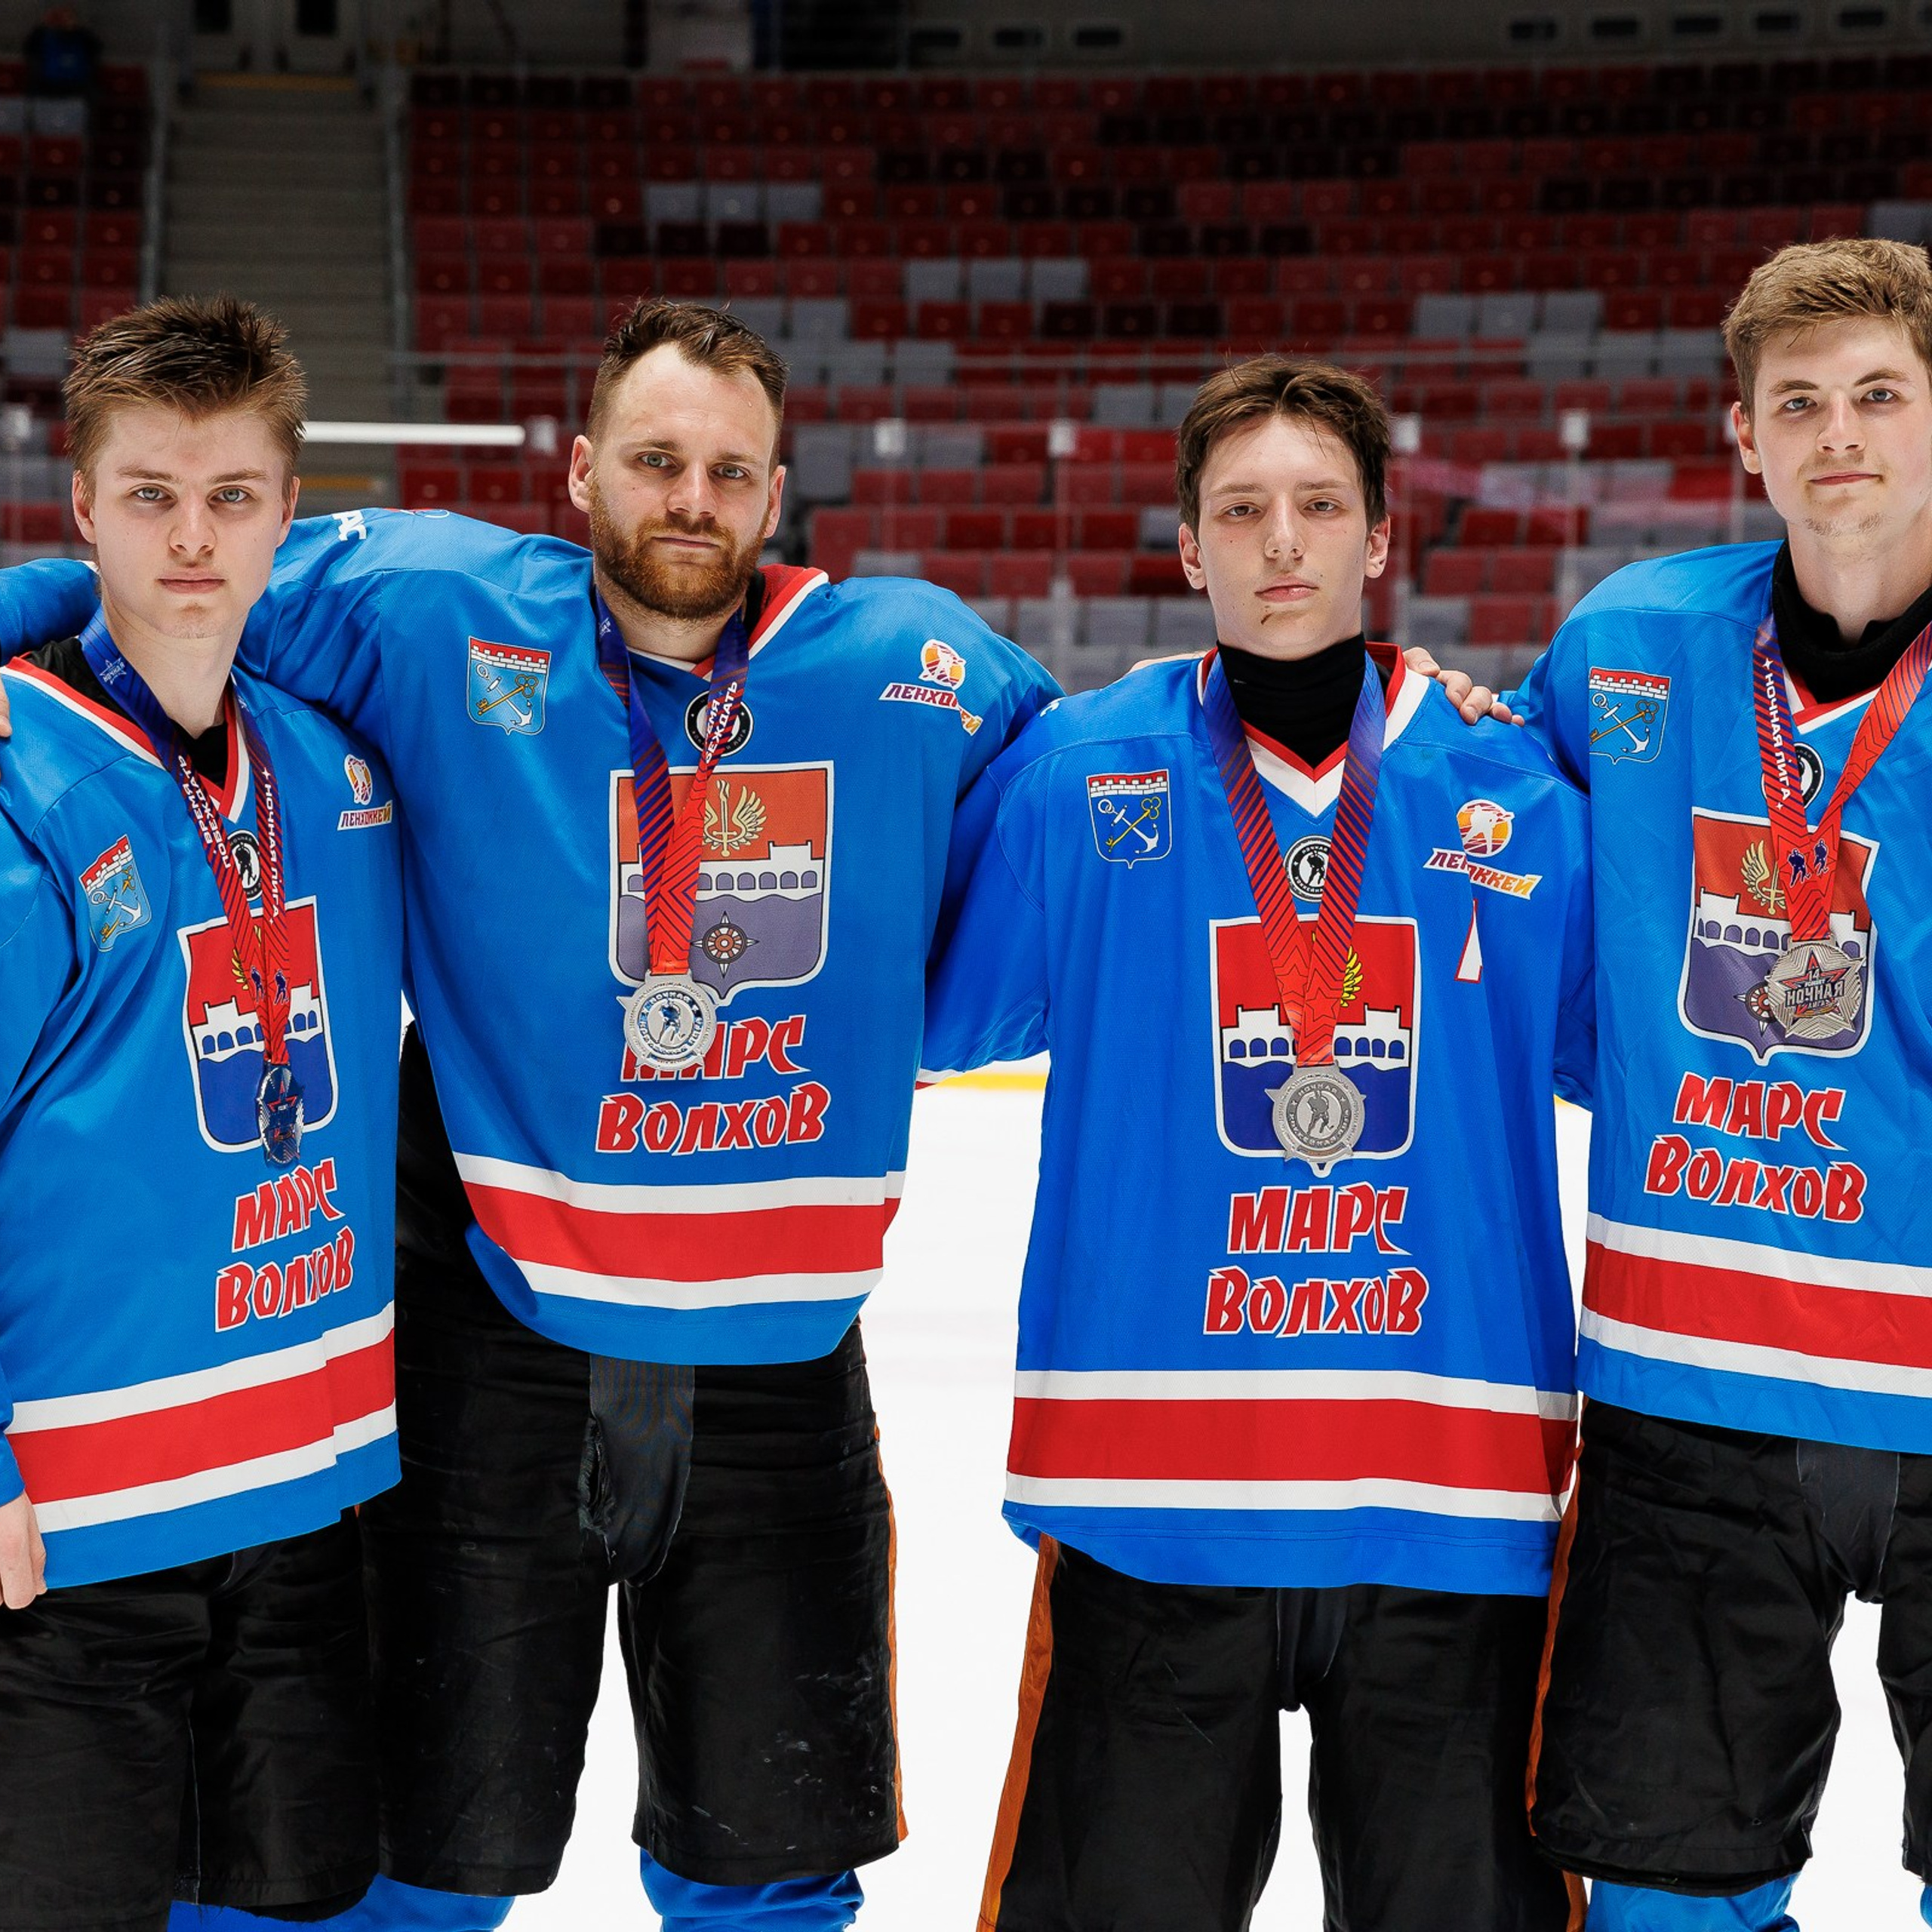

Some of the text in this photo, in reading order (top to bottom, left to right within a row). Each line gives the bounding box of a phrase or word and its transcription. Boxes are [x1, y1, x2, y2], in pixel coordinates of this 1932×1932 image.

[1765, 672, 1791, 801] НОЧНАЯ ЛИГА
[178, 755, 231, 869] ПОБЕЖДАТЬ
[182, 783, 213, 844] ВРЕМЯ
[264, 783, 279, 918] НОЧНАЯ ЛИГА
[1786, 980, 1844, 1007] НОЧНАЯ
[595, 1081, 831, 1157] ВОЛХОВ
[1672, 1071, 1848, 1152] МАРС
[232, 1157, 346, 1253] МАРС
[1227, 1181, 1413, 1255] МАРС
[1644, 1134, 1867, 1224] ВОЛХОВ
[215, 1225, 355, 1333] ВОЛХОВ
[1203, 1265, 1429, 1339] ВОЛХОВ
